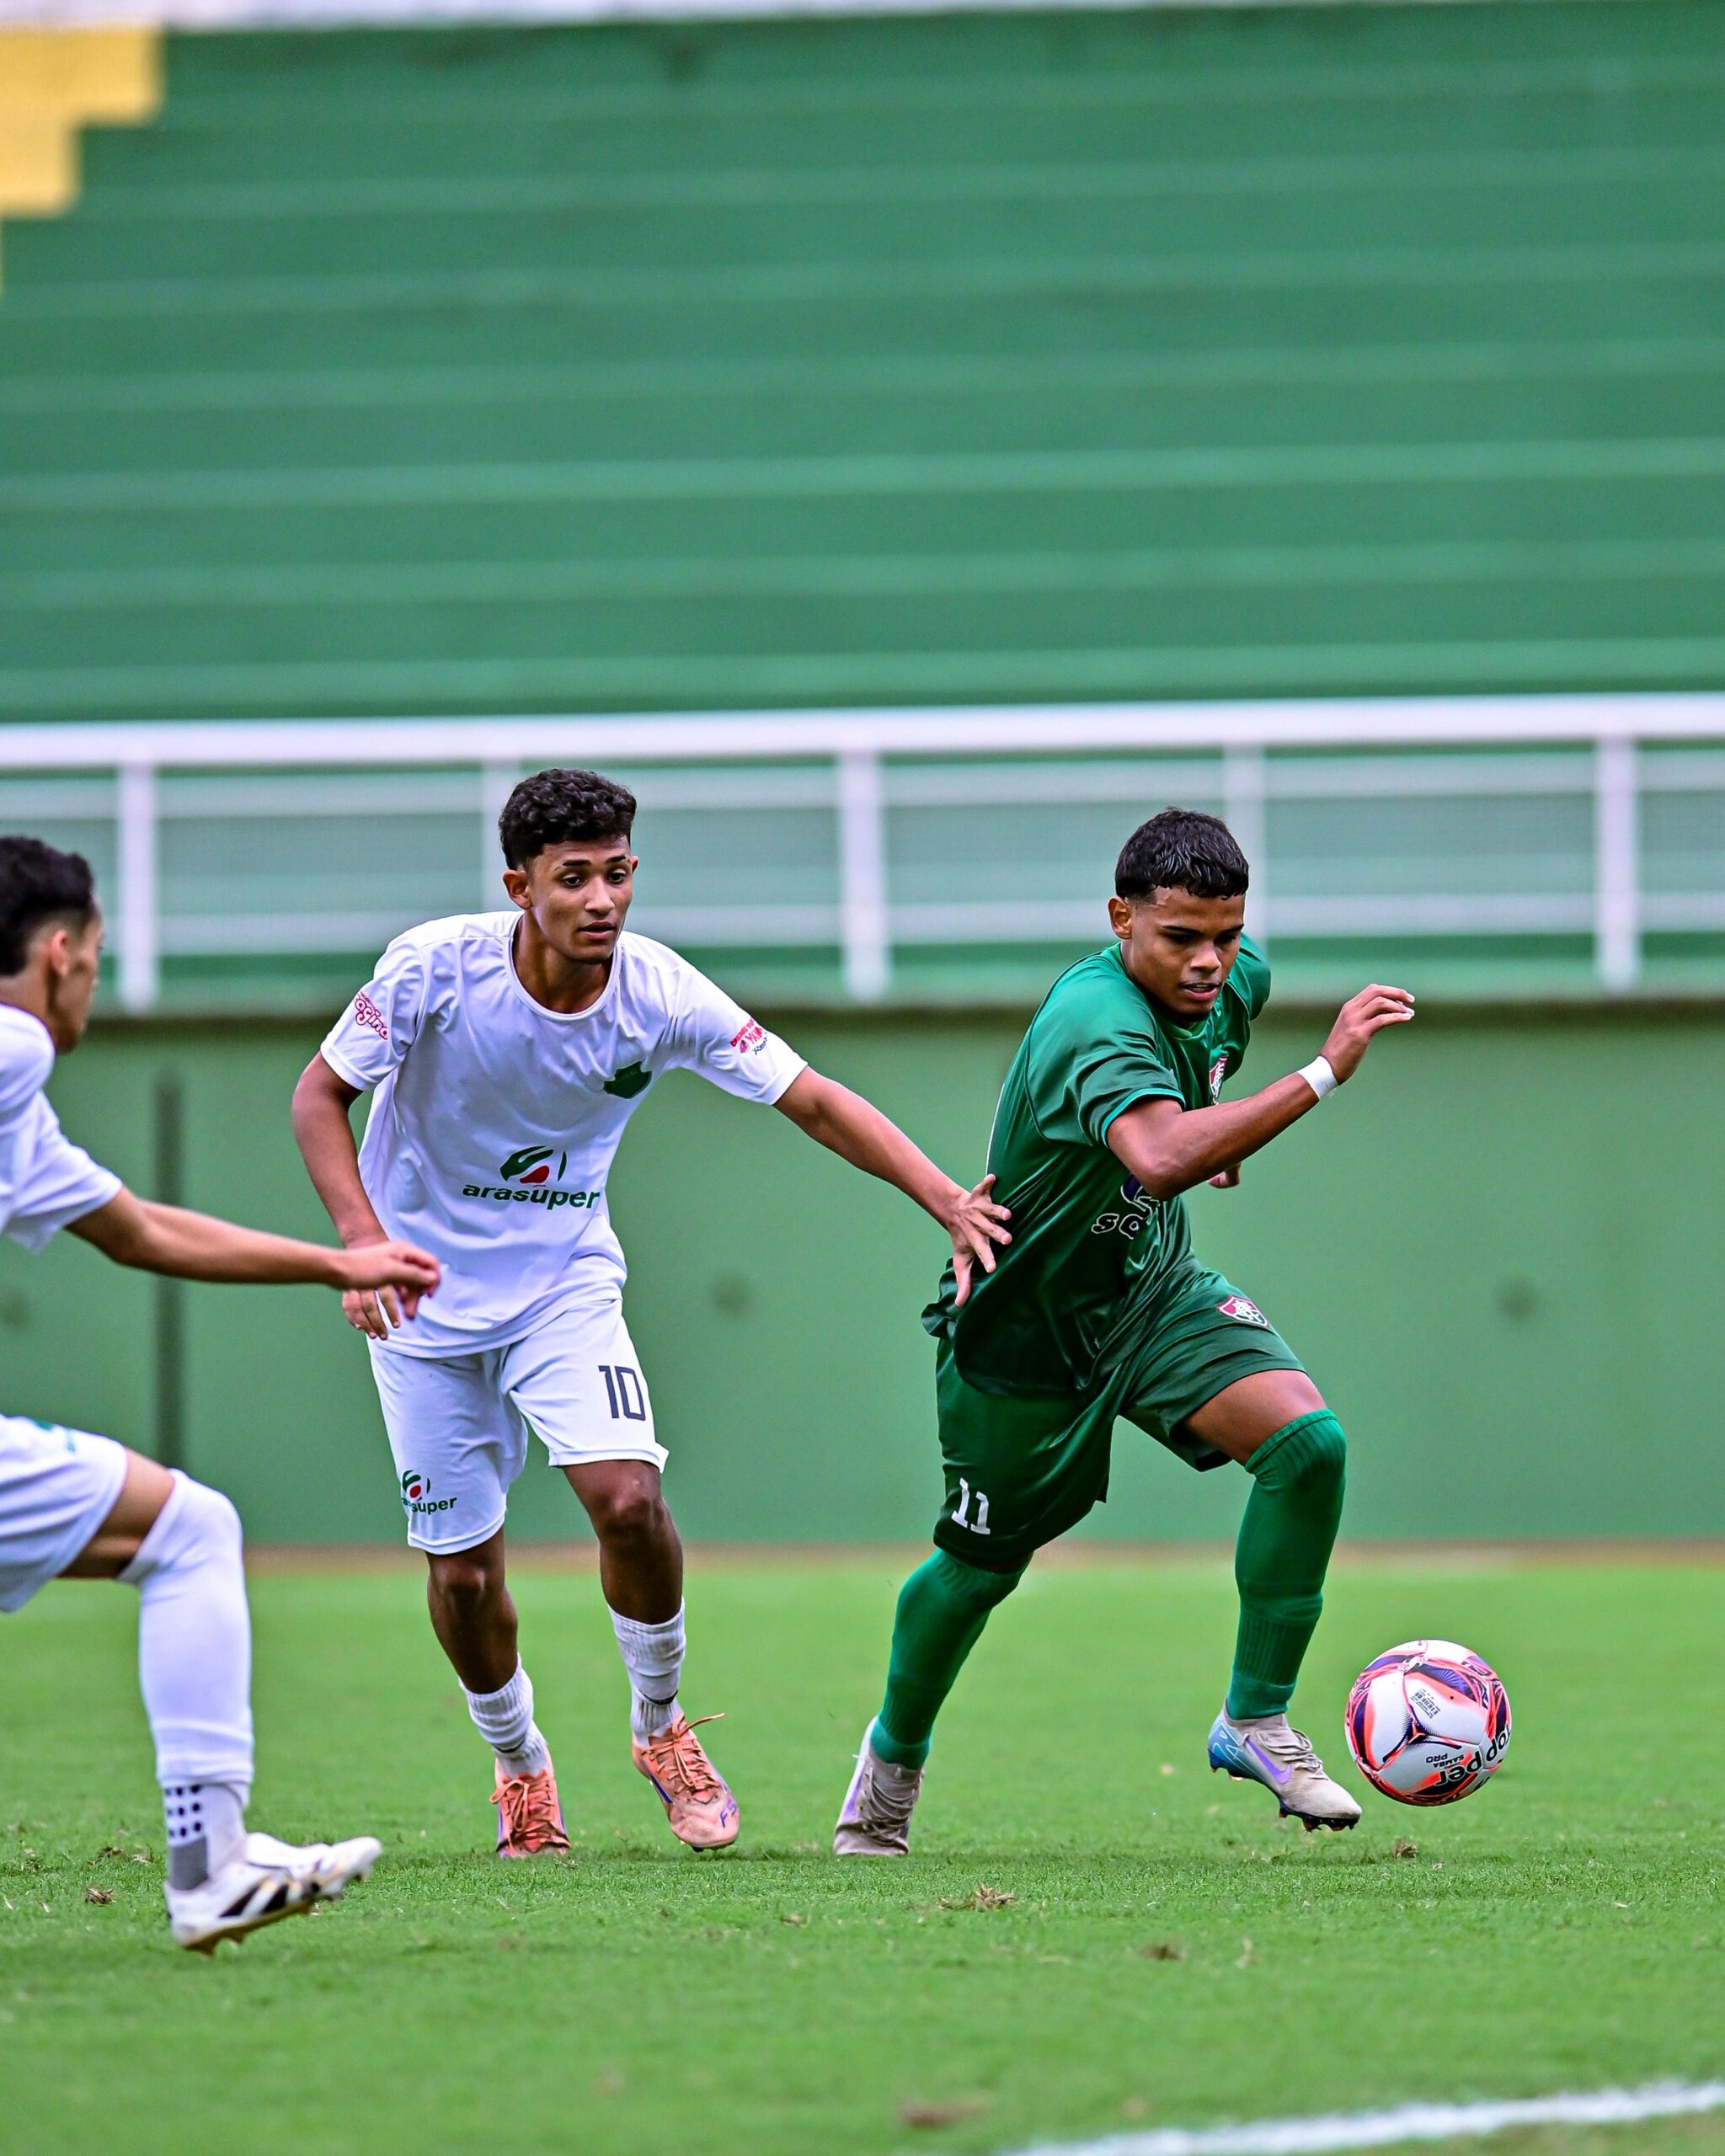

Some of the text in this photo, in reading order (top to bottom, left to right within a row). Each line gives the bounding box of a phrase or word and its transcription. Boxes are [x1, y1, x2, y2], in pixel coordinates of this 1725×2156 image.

[355, 994, 388, 1041] agina
[462, 1183, 601, 1210] arasuper
[598, 1365, 646, 1422] 10
[951, 1476, 991, 1535] 11
[1426, 1753, 1448, 1764] PRO
[1433, 1754, 1465, 1768] SAMBA
